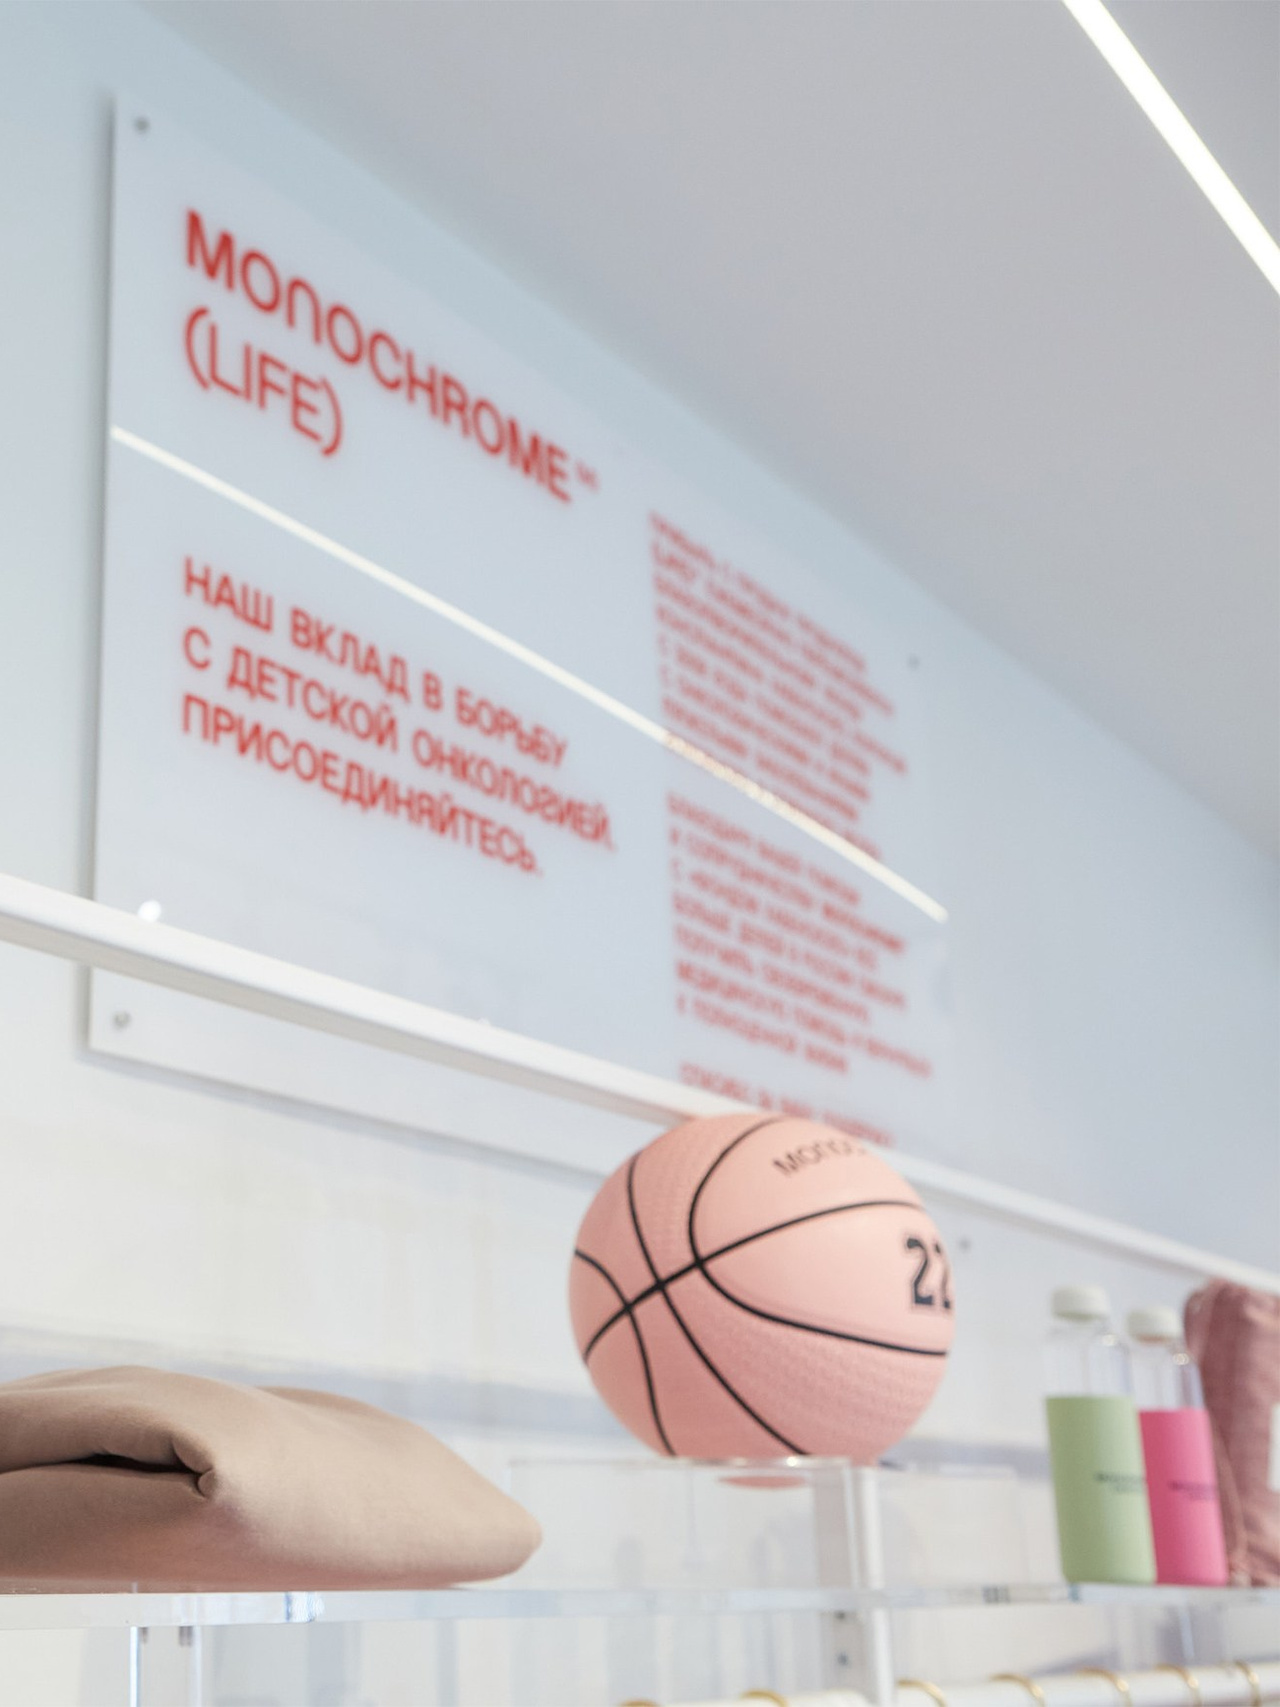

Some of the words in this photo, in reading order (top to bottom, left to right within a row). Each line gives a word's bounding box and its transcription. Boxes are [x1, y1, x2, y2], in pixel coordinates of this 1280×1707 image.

[184, 305, 344, 458] (LIFE)
[182, 625, 212, 671] С
[227, 645, 399, 753] ДЕТСКОЙ
[184, 556, 275, 634] НАШ
[290, 606, 411, 702] ВКЛАД
[422, 670, 444, 711] В
[455, 686, 569, 769] БОРЬБУ
